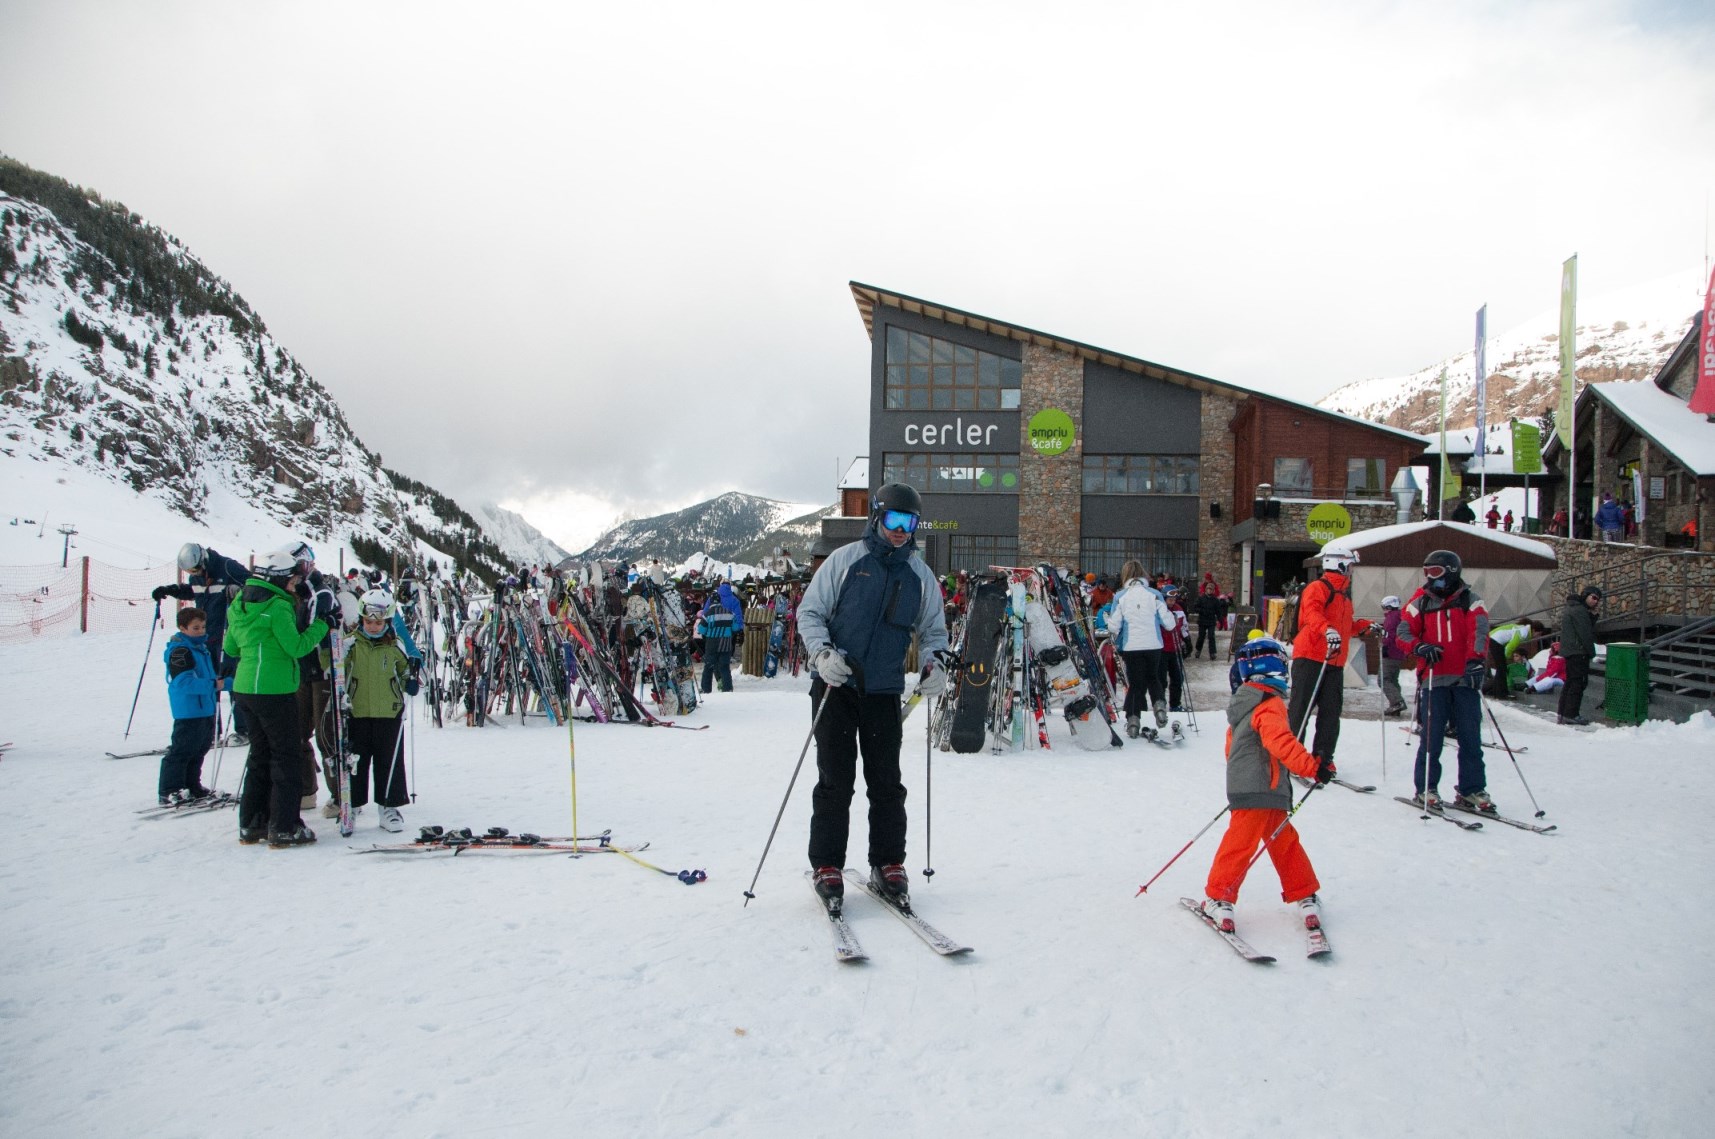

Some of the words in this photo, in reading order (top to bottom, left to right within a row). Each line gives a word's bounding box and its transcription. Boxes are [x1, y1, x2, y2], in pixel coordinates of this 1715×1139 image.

[905, 417, 998, 445] cerler
[1031, 427, 1067, 439] ampriu
[1031, 437, 1062, 449] &café
[1310, 519, 1345, 529] ampriu
[1310, 530, 1334, 541] shop
